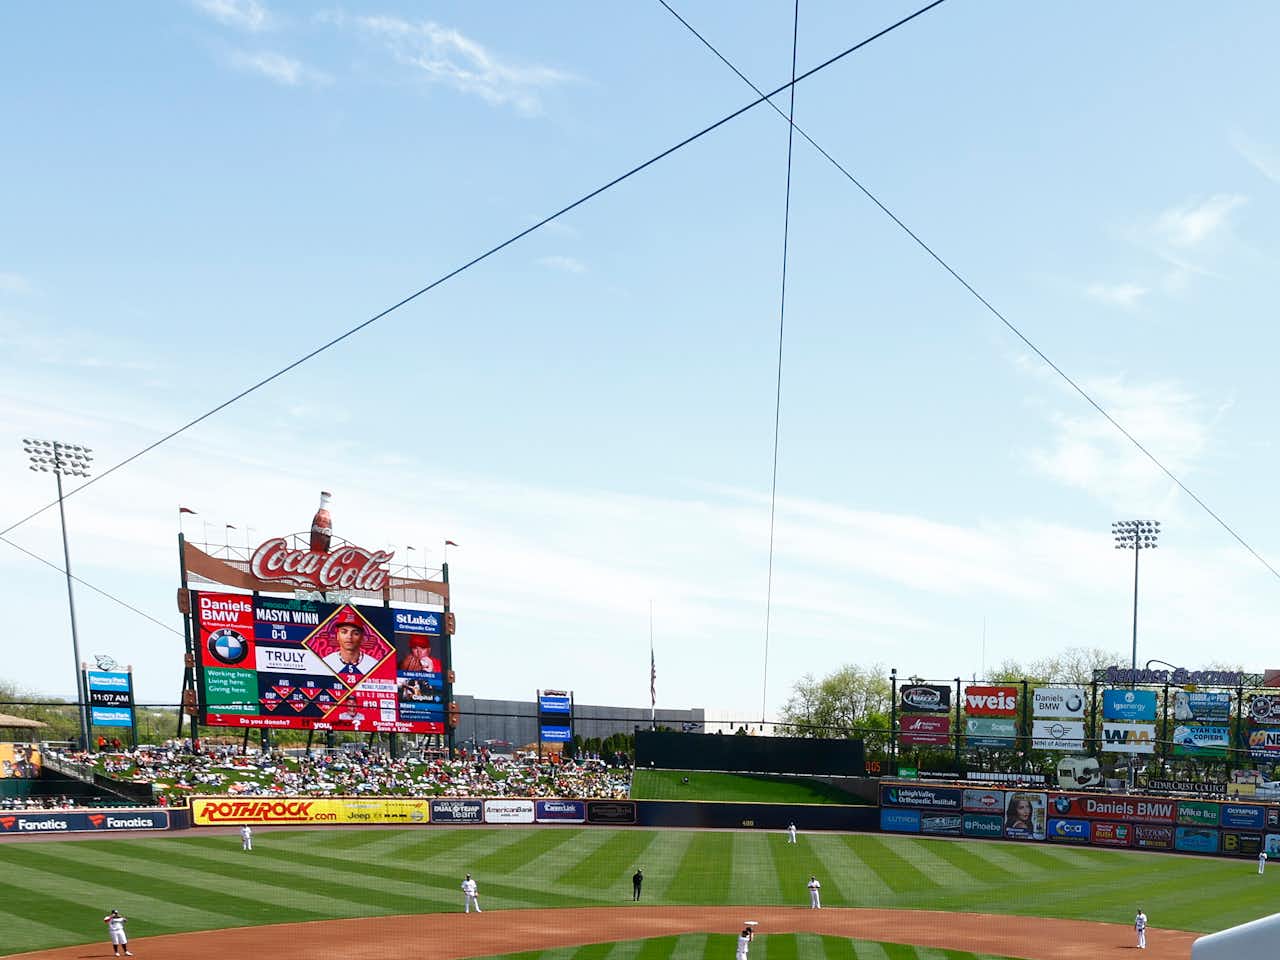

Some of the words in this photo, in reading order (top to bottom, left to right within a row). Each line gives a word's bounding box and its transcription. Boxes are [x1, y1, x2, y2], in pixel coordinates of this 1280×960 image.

[252, 538, 393, 590] Coca-Cola
[201, 598, 252, 612] Daniels
[202, 611, 239, 622] BMW
[256, 608, 290, 622] MASYN
[292, 611, 319, 625] WINN
[272, 630, 287, 640] 0-0
[265, 650, 306, 662] TRULY
[208, 670, 236, 679] Working
[209, 678, 229, 687] Living
[209, 686, 231, 694] Giving
[93, 694, 113, 702] 11:07
[966, 692, 1016, 711] weis
[1036, 694, 1063, 702] Daniels
[1039, 702, 1060, 710] BMW
[1105, 730, 1149, 745] WM
[1170, 782, 1194, 791] CREST
[898, 797, 931, 806] Orthopedic
[1087, 800, 1134, 816] Daniels
[1137, 802, 1173, 817] BMW
[1180, 807, 1201, 816] Mike
[1203, 809, 1217, 819] Ike
[1227, 807, 1258, 816] OLYMPUS
[347, 811, 371, 820] Jeep
[452, 811, 476, 819] team
[19, 819, 67, 830] Fanatics
[107, 817, 153, 828] Fanatics
[972, 821, 1001, 832] Phoebe
